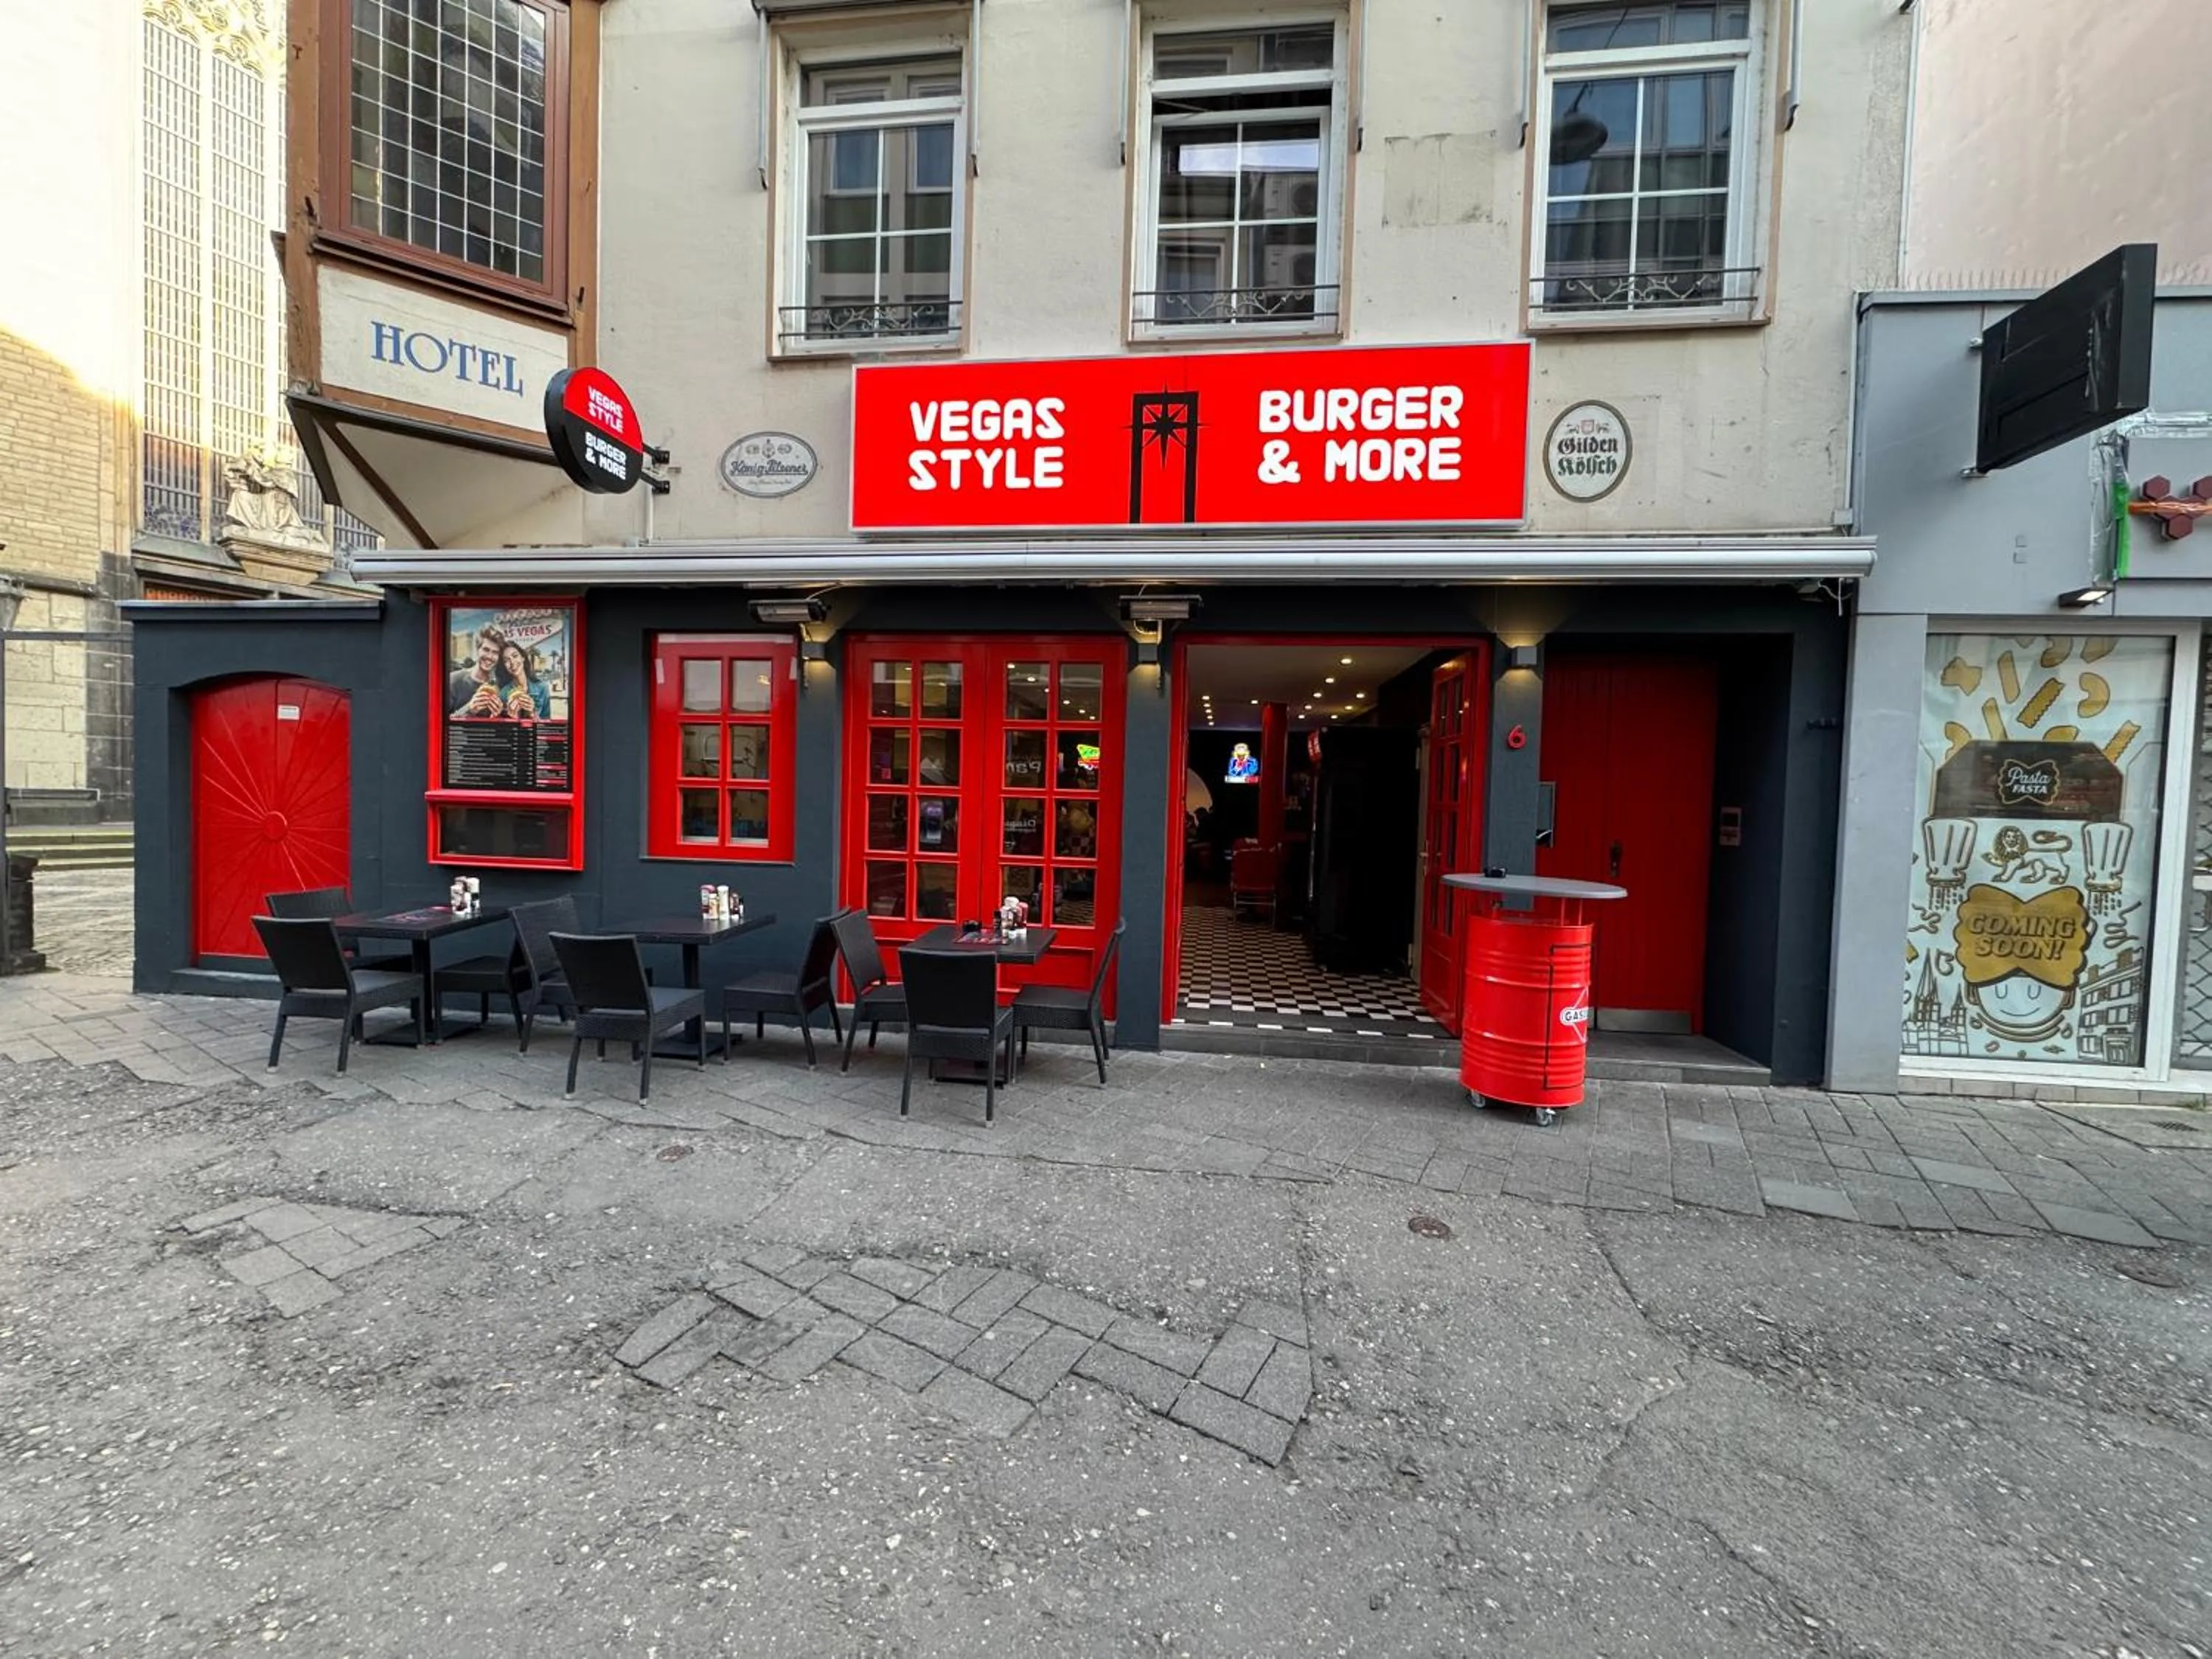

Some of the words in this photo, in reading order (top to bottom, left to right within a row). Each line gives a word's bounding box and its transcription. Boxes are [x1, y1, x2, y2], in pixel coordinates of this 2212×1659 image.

[371, 321, 524, 397] HOTEL
[588, 384, 624, 419] VEGAS
[588, 400, 624, 434] STYLE
[1258, 385, 1464, 433] BURGER
[909, 397, 1065, 442] VEGAS
[585, 431, 627, 465] BURGER
[1258, 439, 1301, 484] &
[1324, 437, 1462, 482] MORE
[1557, 436, 1618, 454] Gilden
[585, 446, 597, 465] &
[599, 454, 627, 481] MORE
[908, 445, 1065, 491] STYLE
[1557, 455, 1618, 477] Kölsch
[1509, 724, 1526, 749] 6
[2006, 767, 2052, 787] Pasta
[1967, 914, 2076, 939] COMING
[1974, 936, 2065, 961] SOON!
